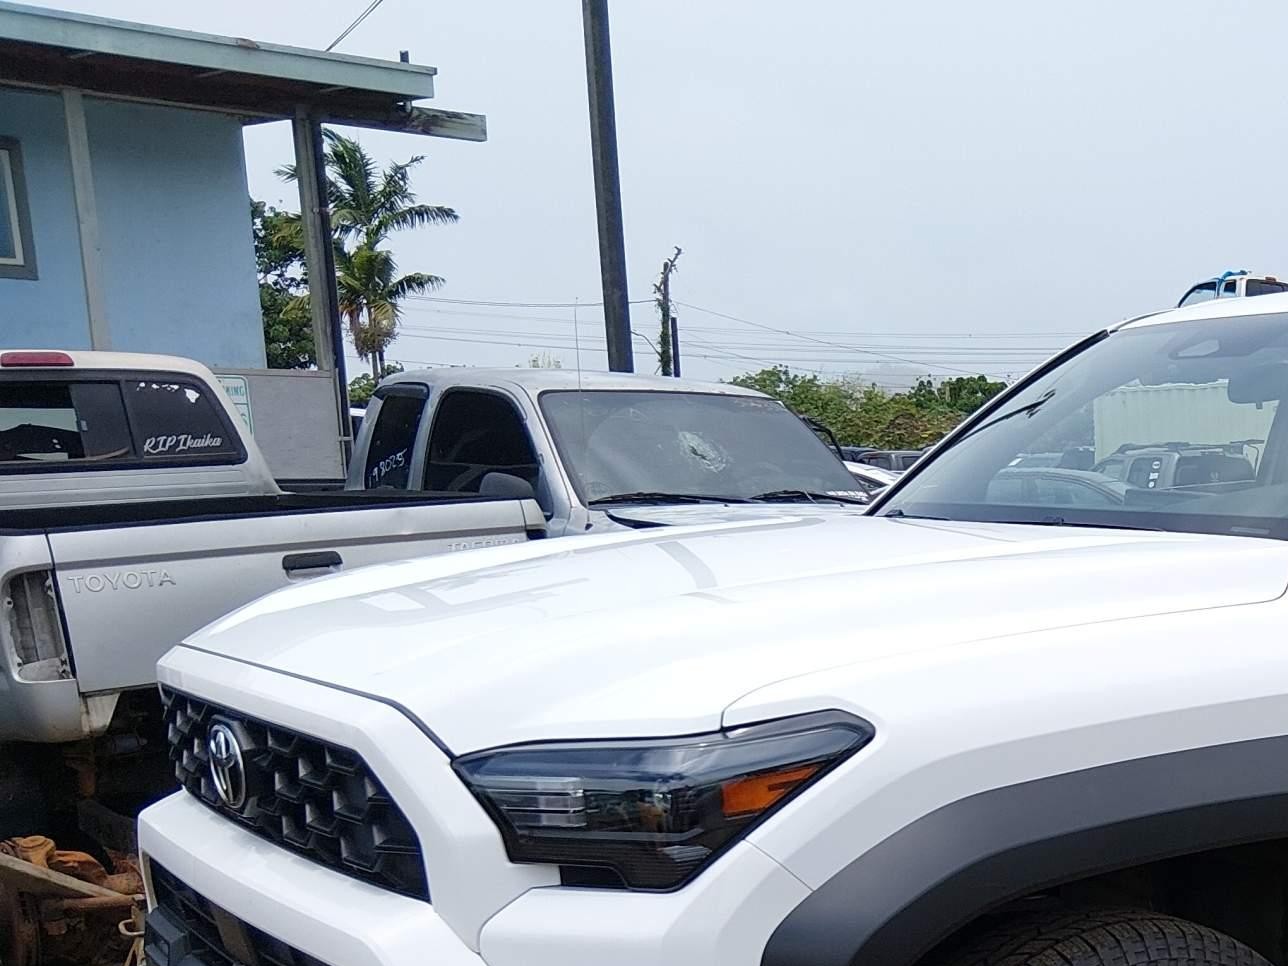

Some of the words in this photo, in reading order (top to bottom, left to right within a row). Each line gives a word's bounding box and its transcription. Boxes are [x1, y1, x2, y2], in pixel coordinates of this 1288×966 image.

[143, 435, 177, 454] RIP
[175, 431, 222, 452] Ikaika
[66, 569, 177, 594] TOYOTA
